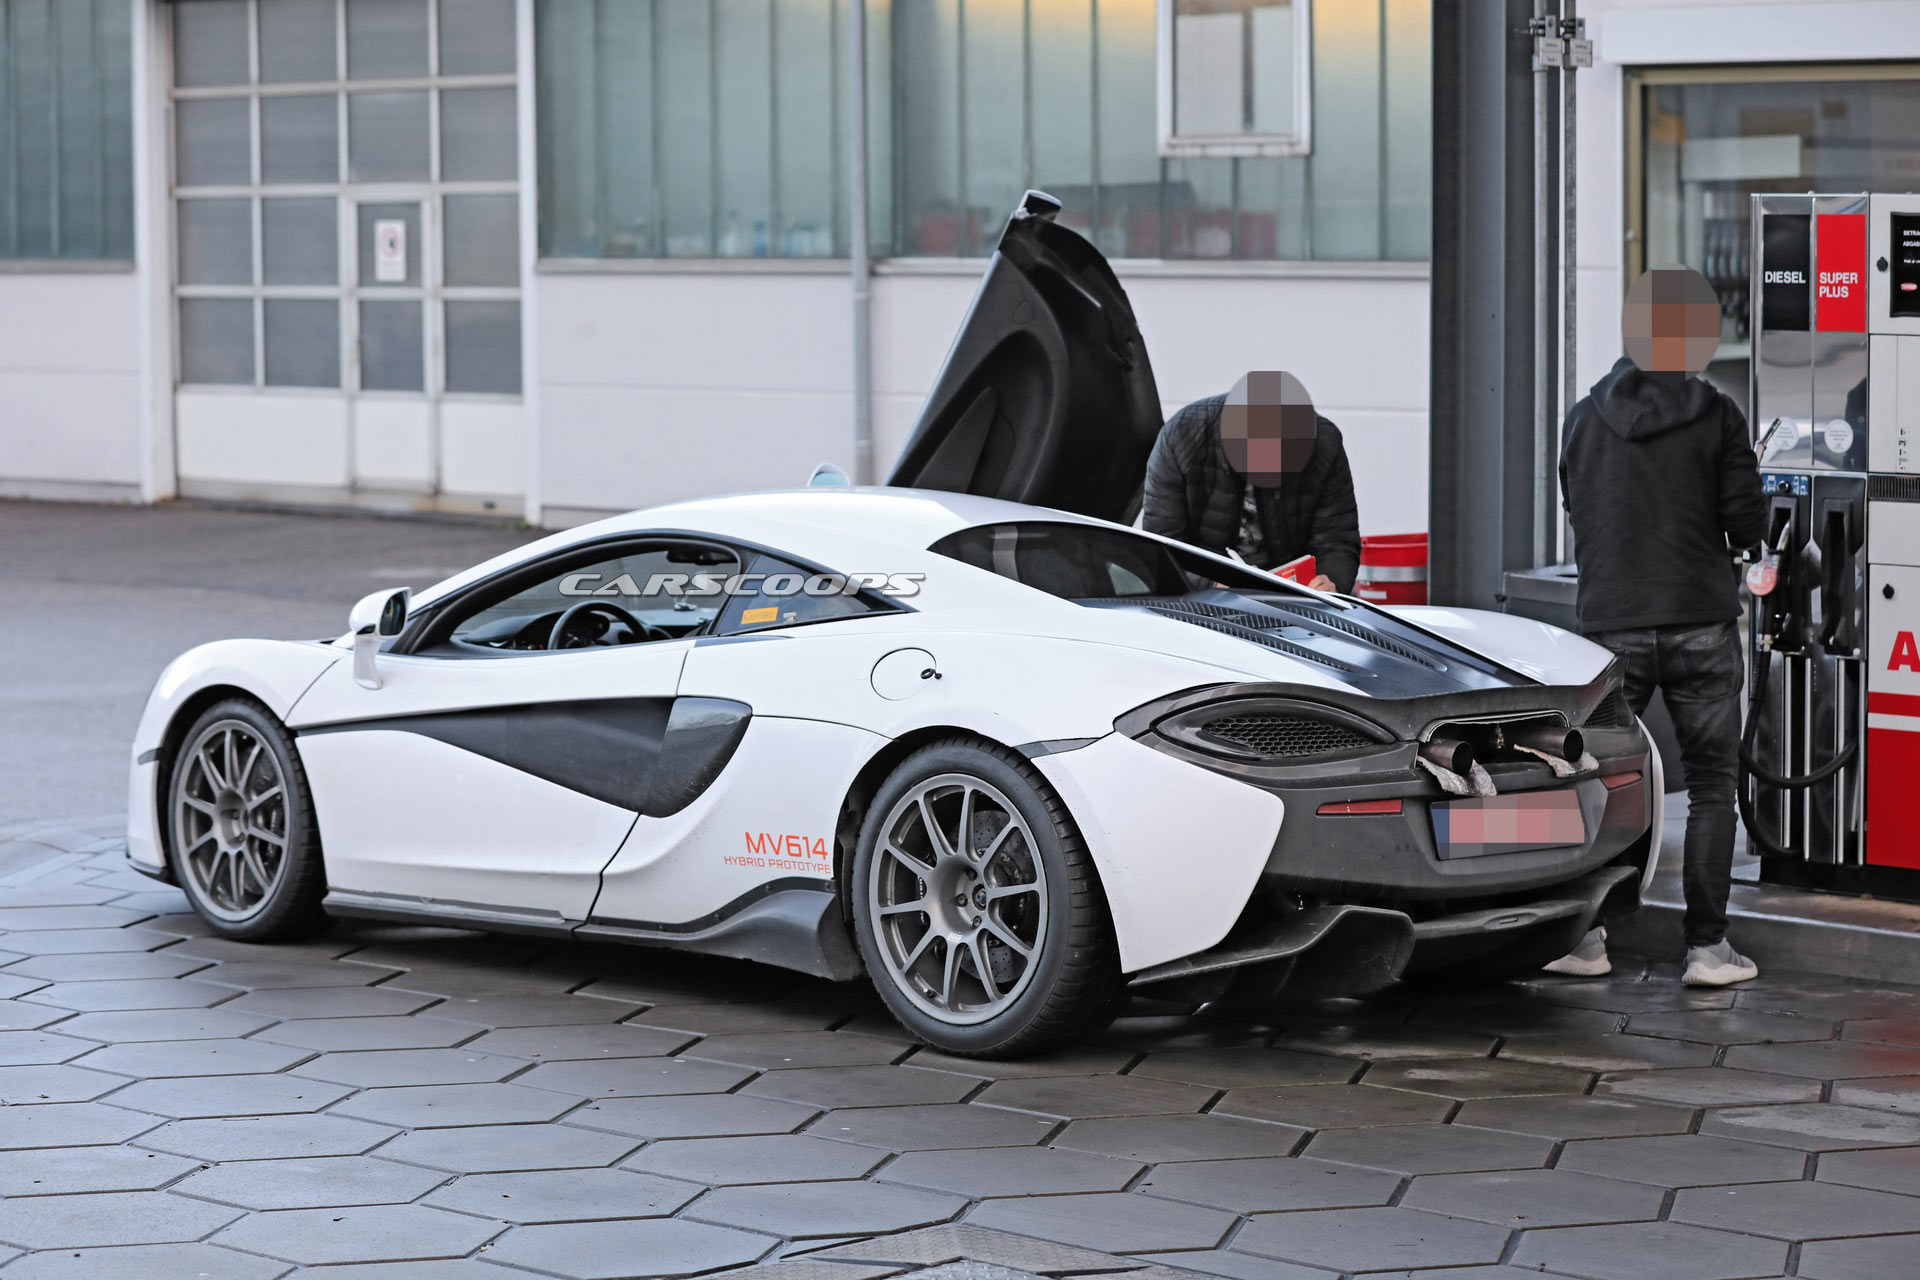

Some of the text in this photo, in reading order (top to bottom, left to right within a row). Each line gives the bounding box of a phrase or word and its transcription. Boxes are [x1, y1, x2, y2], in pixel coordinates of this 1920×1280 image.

[1764, 271, 1806, 284] DIESEL
[1819, 272, 1858, 284] SUPER
[1819, 286, 1849, 298] PLUS
[745, 832, 828, 860] MV614
[724, 856, 831, 874] HYBRID PROTOTYPE
